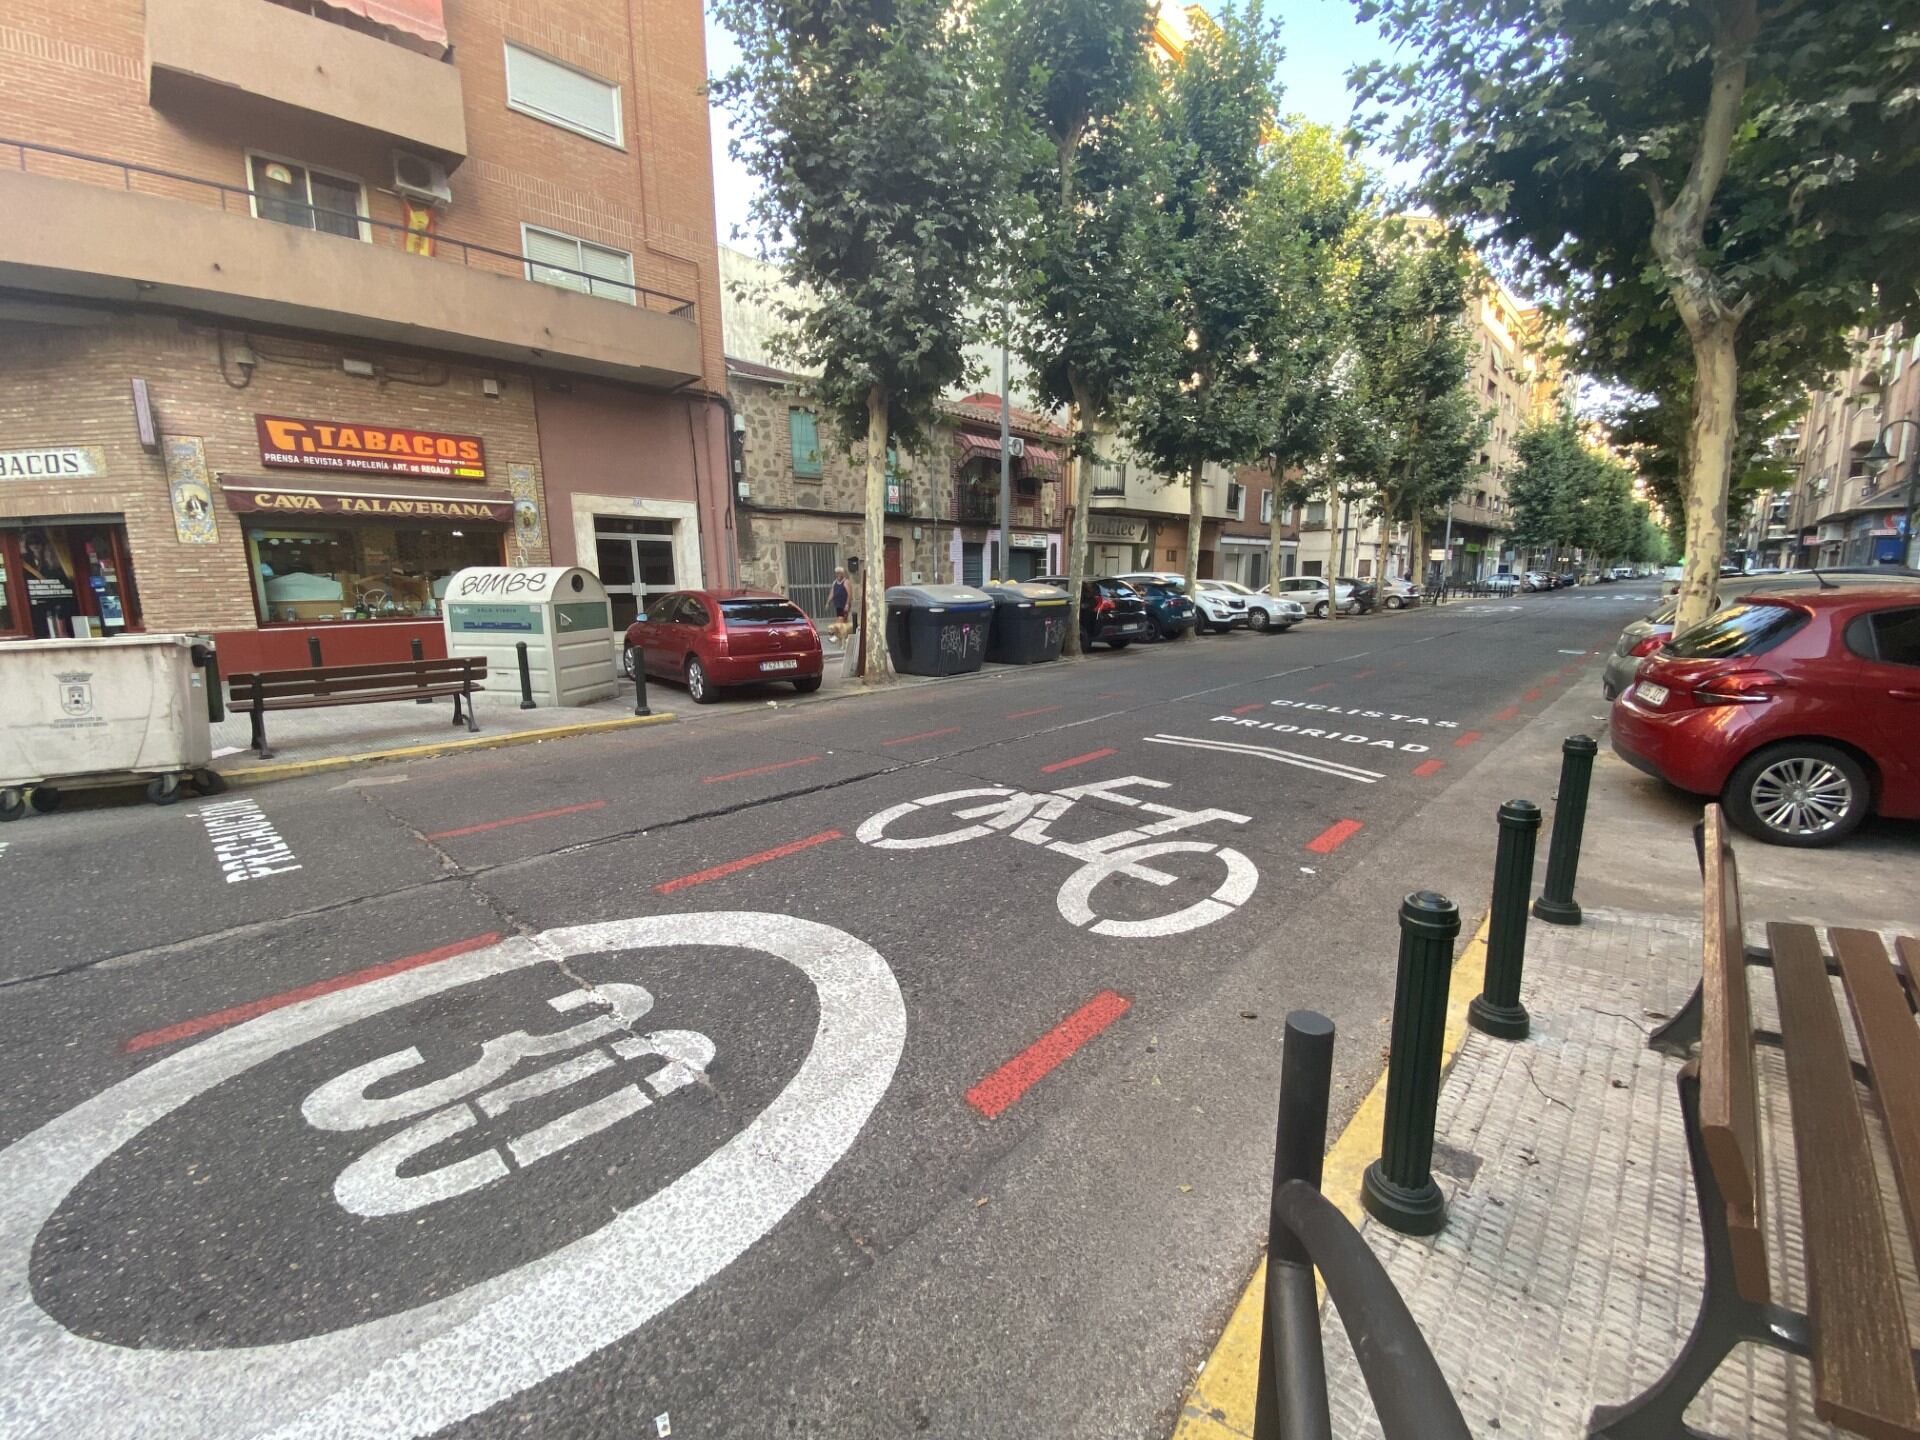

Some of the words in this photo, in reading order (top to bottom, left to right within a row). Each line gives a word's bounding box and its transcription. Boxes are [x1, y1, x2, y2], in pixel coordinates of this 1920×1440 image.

[313, 426, 480, 460] TABACOS
[264, 453, 300, 464] PRENSA
[303, 455, 343, 467] REVISTAS
[347, 459, 389, 470] PAPELERÍA
[393, 463, 408, 471] ART.
[421, 465, 450, 474] REGALO
[254, 493, 323, 510] CAVA
[337, 498, 493, 516] TALAVERANA
[1270, 699, 1460, 728] CICLISTAS
[1209, 715, 1430, 753] PRIORIDAD
[301, 983, 716, 1217] 30
